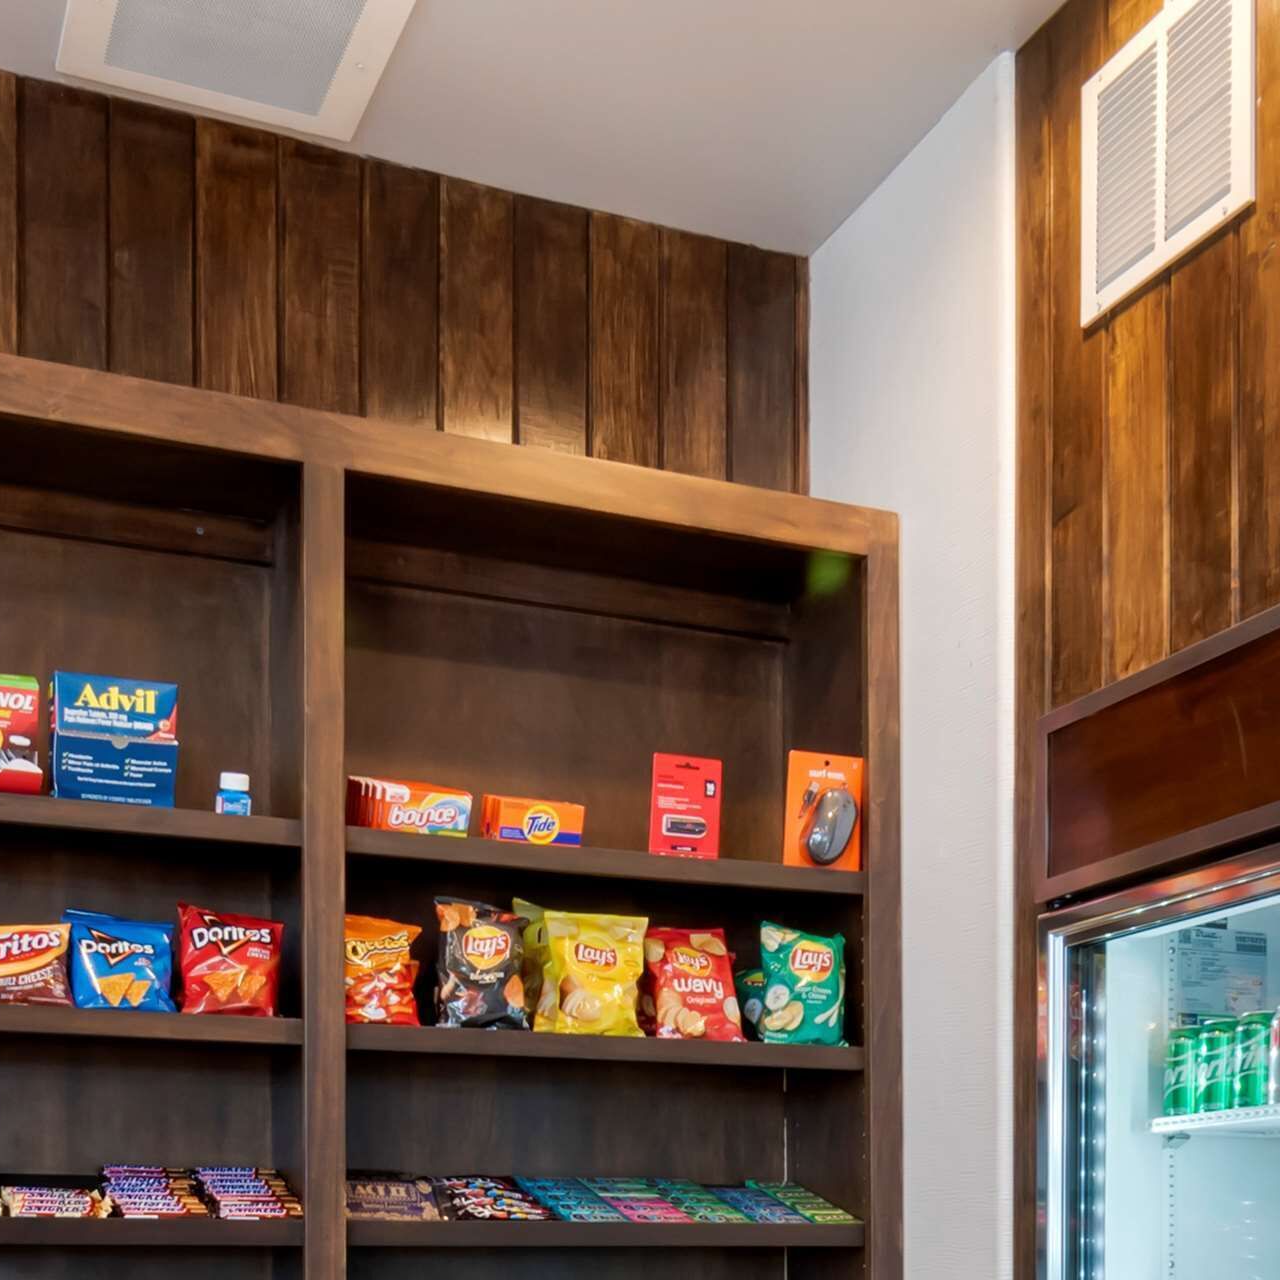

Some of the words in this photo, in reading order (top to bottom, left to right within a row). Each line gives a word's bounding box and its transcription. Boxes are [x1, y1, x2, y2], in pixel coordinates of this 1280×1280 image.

[73, 683, 157, 715] Advil
[389, 805, 457, 826] bounce
[527, 815, 556, 835] Tide
[80, 938, 154, 957] Doritos
[191, 926, 271, 949] Doritos
[467, 936, 506, 960] Lay's
[576, 942, 616, 967] Lay's
[793, 948, 832, 974] Lay's
[674, 978, 724, 998] wavy
